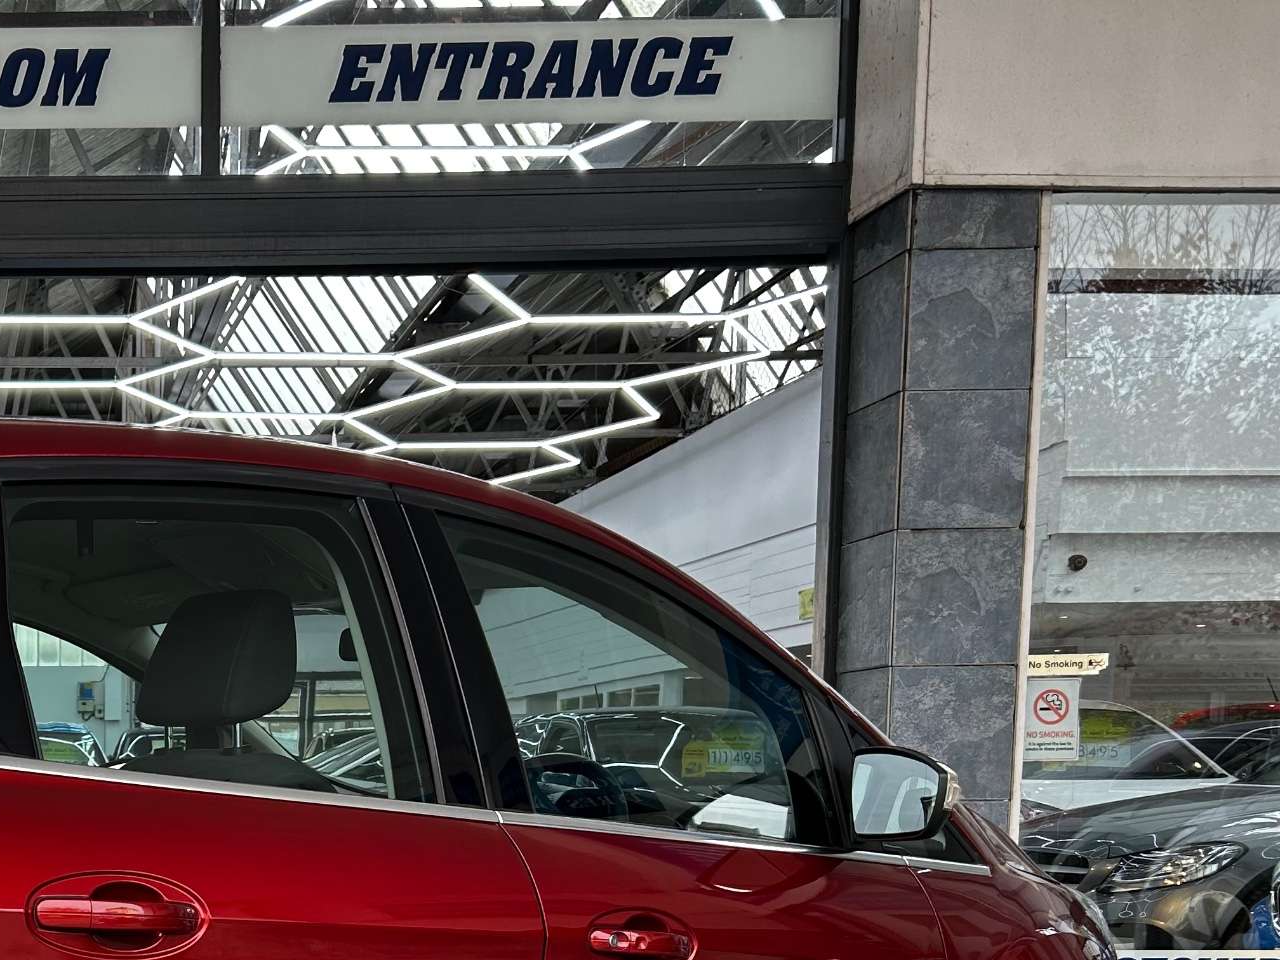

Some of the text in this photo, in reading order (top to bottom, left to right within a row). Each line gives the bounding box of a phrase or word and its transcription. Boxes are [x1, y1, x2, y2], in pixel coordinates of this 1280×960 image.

[329, 36, 733, 103] ENTRANCE
[1028, 659, 1083, 669] No Smoking
